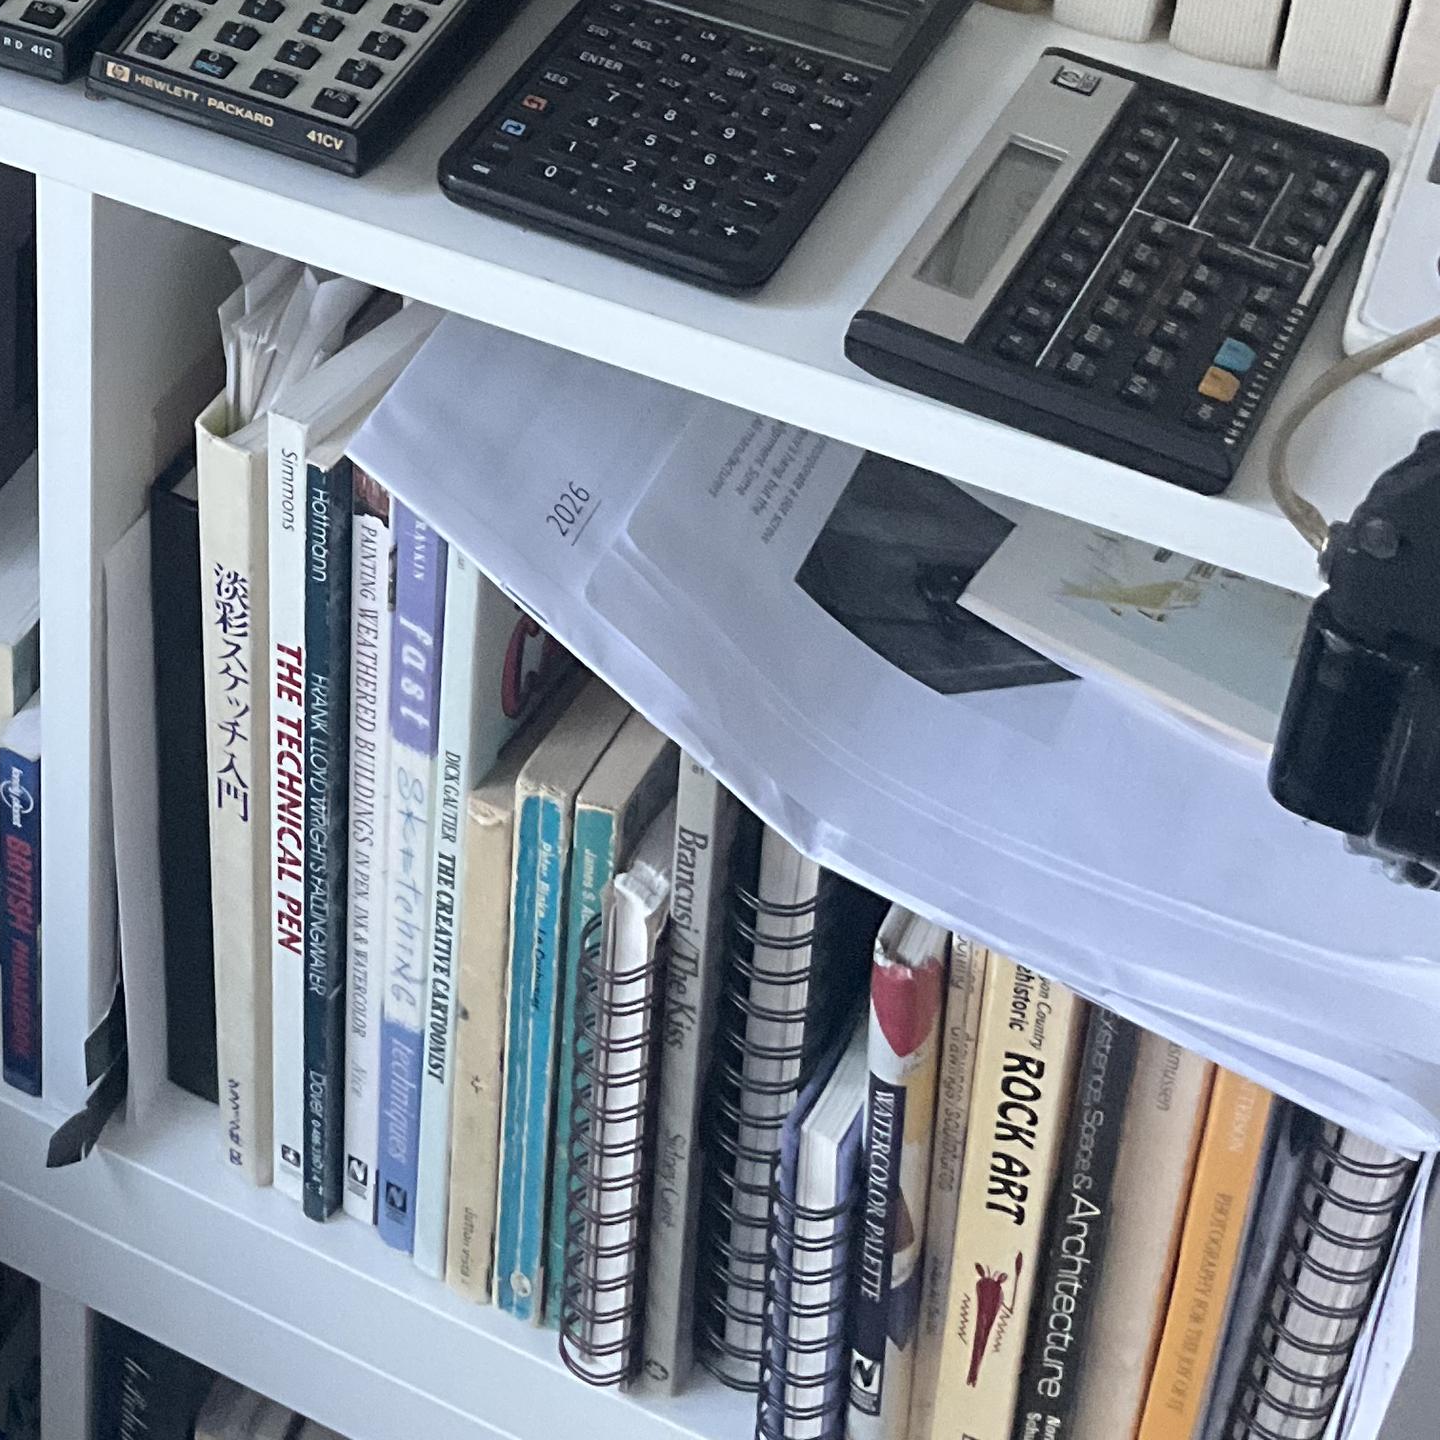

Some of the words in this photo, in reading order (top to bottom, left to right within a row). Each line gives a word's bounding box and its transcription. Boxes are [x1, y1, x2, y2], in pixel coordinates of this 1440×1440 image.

[29, 43, 54, 60] 41C
[579, 50, 624, 72] ENTER
[134, 73, 201, 104] HEWLETT
[206, 96, 275, 128] PACKARD
[305, 129, 344, 151] 41CV
[323, 89, 350, 103] R/S
[657, 203, 682, 218] R/S
[1228, 376, 1268, 439] HEWLETT
[1263, 305, 1306, 372] PACKARD
[280, 447, 298, 532] Simmons
[546, 481, 592, 538] 2026
[310, 485, 329, 582] Hoffmann
[359, 524, 378, 602] PAINTING
[213, 562, 249, 823] 淡彩スケッチ入門
[275, 642, 303, 708] THE
[310, 672, 329, 736] FRANK
[355, 606, 379, 734] WEATHERED
[399, 615, 435, 729] fast
[272, 712, 304, 882] TECHNICAL
[309, 736, 328, 794] LLOYD
[352, 737, 377, 848] BUILDINGS
[442, 750, 461, 782] DICK
[439, 782, 459, 843] GAUTIER
[6, 834, 35, 936] BRITISH
[353, 867, 370, 904] PEN,
[355, 848, 370, 866] IN
[438, 851, 457, 888] THE
[273, 895, 303, 956] PEN
[308, 875, 329, 997] FALLINGWATER
[353, 906, 369, 933] INK
[433, 890, 455, 976] CREATIVE
[351, 947, 369, 1039] WATERCOLOR
[666, 1000, 698, 1051] Kiss
[1029, 1001, 1052, 1051] Country
[427, 977, 451, 1085] CARTOONIST
[309, 1069, 328, 1120] Dover
[384, 1037, 416, 1164] techniques
[994, 1051, 1045, 1150] ROCK
[866, 1090, 895, 1219] WATERCOLOR
[1079, 1109, 1105, 1174] Space
[985, 1151, 1031, 1226] ART
[1072, 1172, 1093, 1191] &
[859, 1218, 885, 1303] PALETTE
[1195, 1191, 1234, 1297] PHOTOGRAPHY
[1036, 1191, 1102, 1401] Architecture
[1189, 1297, 1209, 1323] FOR
